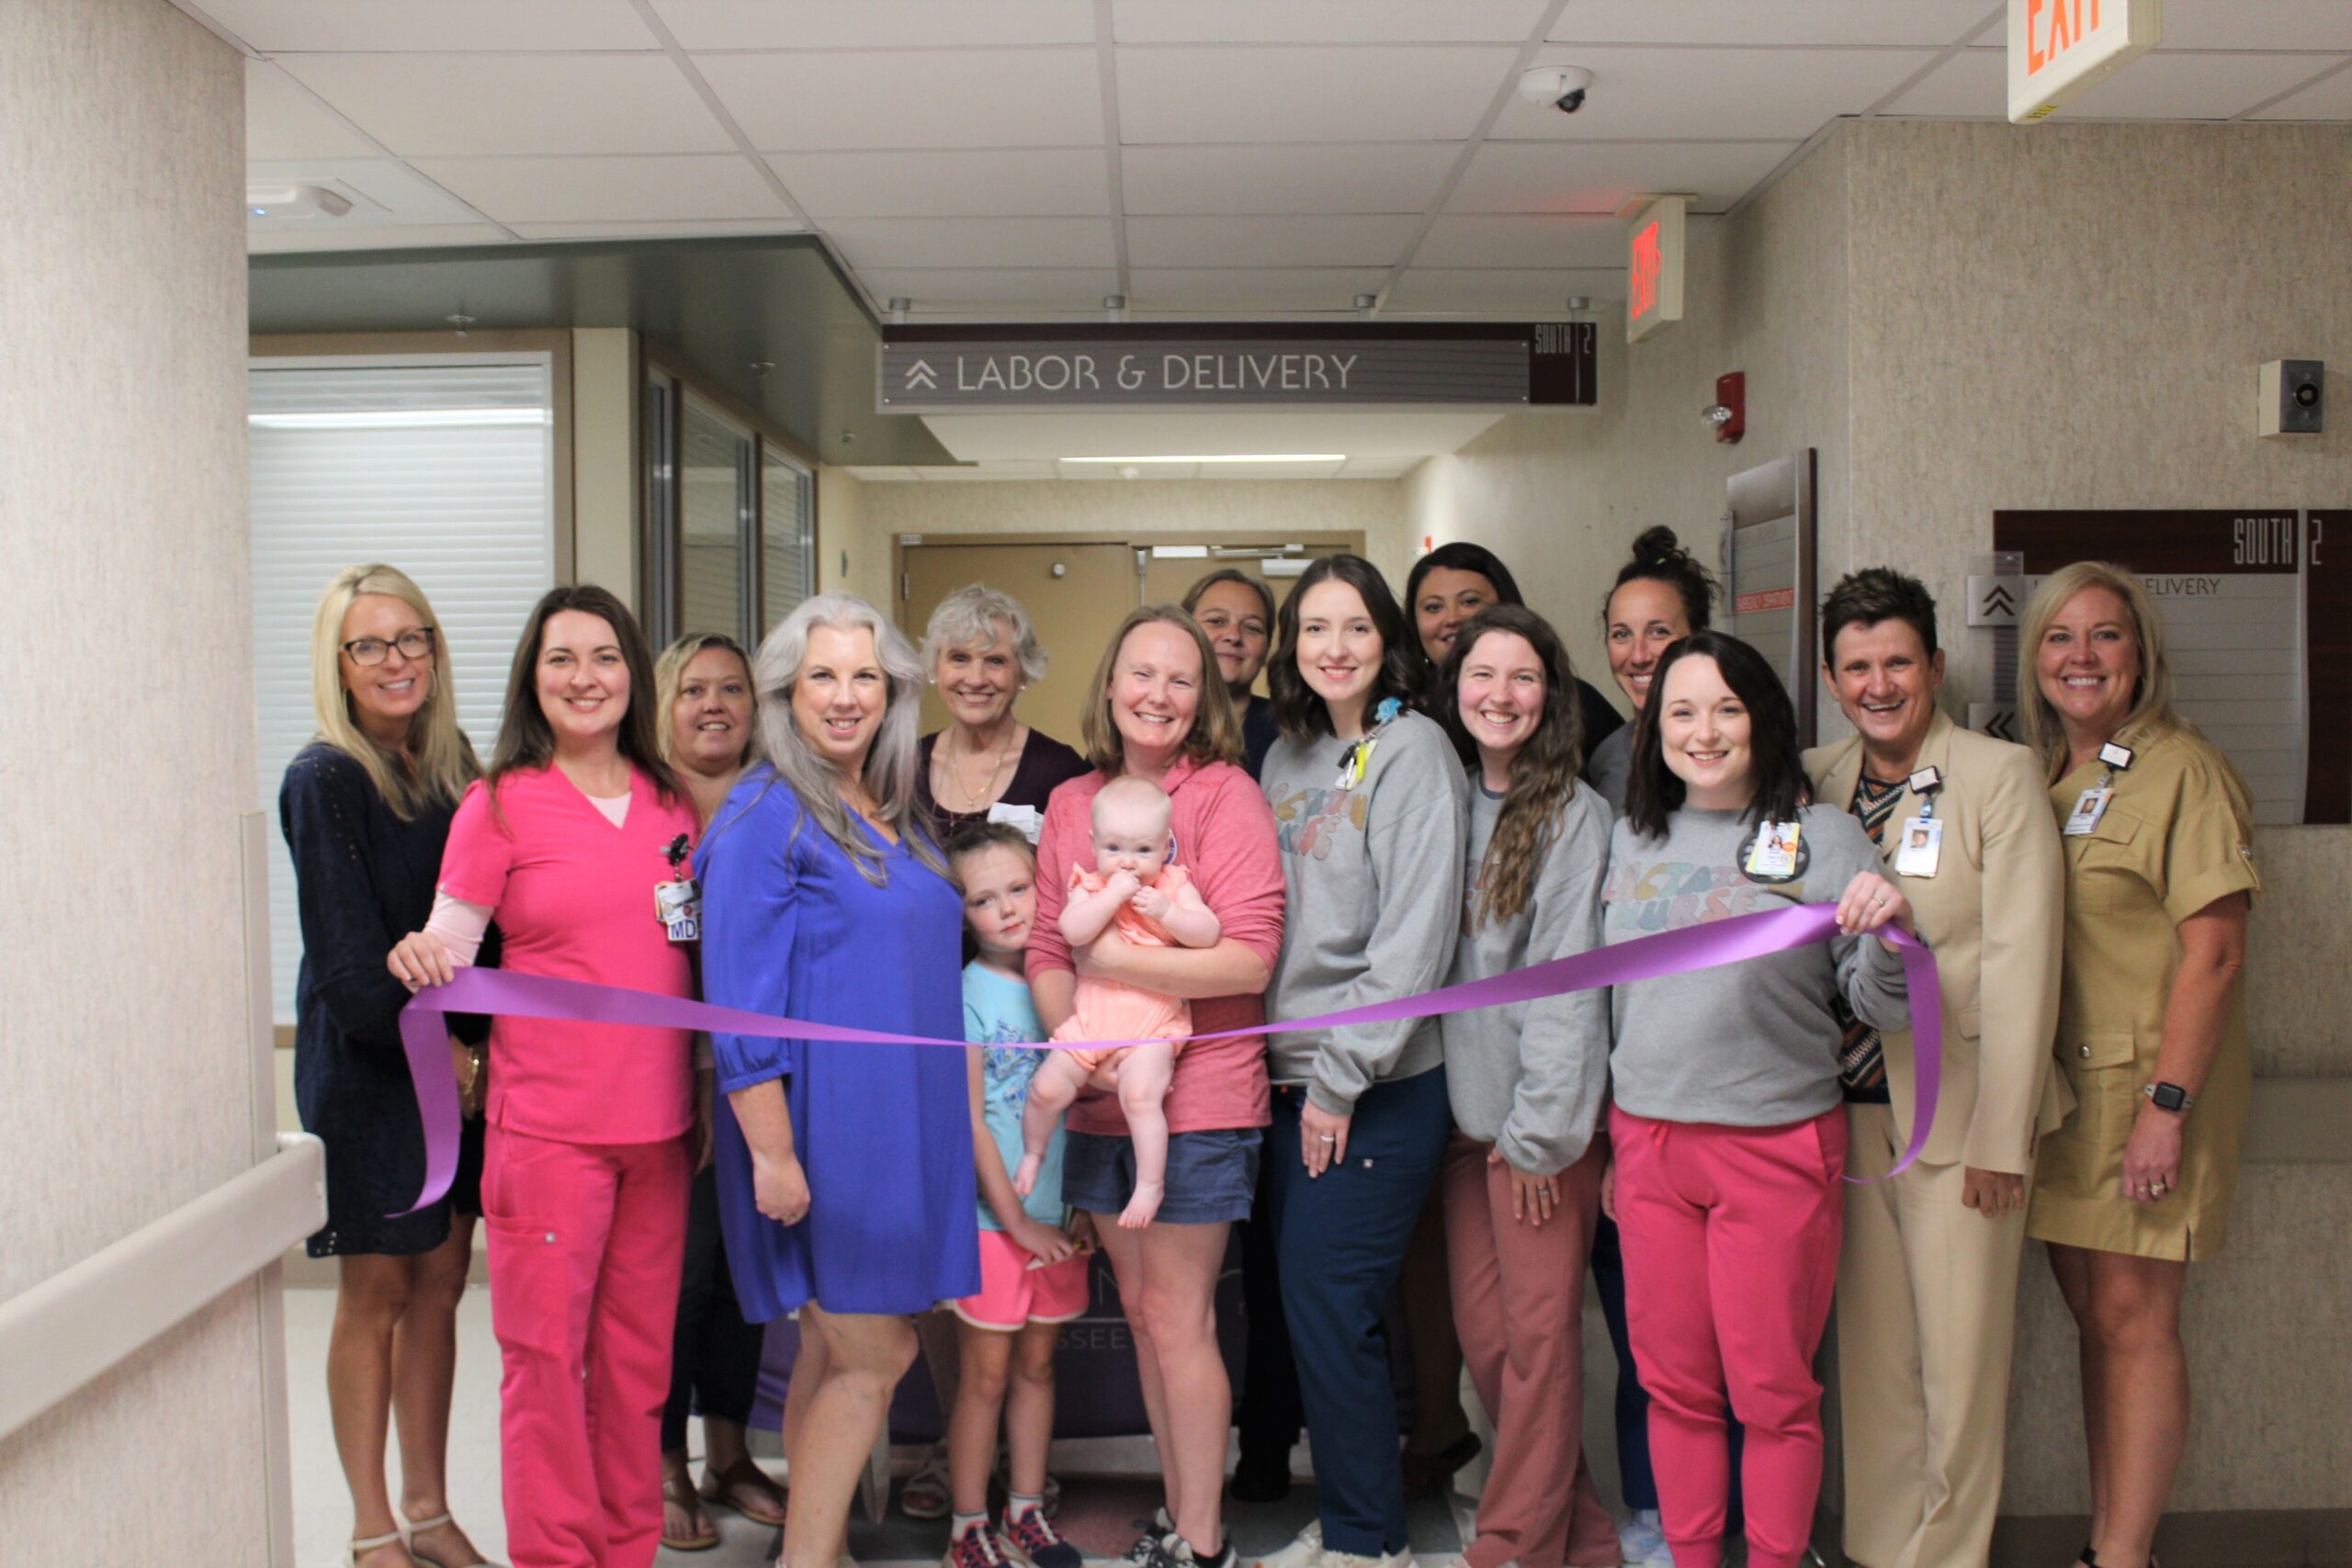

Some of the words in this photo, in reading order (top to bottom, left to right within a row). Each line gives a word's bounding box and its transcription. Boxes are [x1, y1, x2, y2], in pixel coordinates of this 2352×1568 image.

[1535, 324, 1571, 354] SOUTH
[1583, 324, 1591, 354] 2
[957, 355, 1101, 390] LABOR
[1116, 355, 1147, 390] &
[1163, 355, 1358, 389] DELIVERY
[2233, 518, 2292, 565] SOUTH
[2312, 519, 2323, 566] 2
[2140, 578, 2221, 595] ELIVERY
[1614, 886, 1758, 931] NURSE
[671, 919, 696, 938] MD
